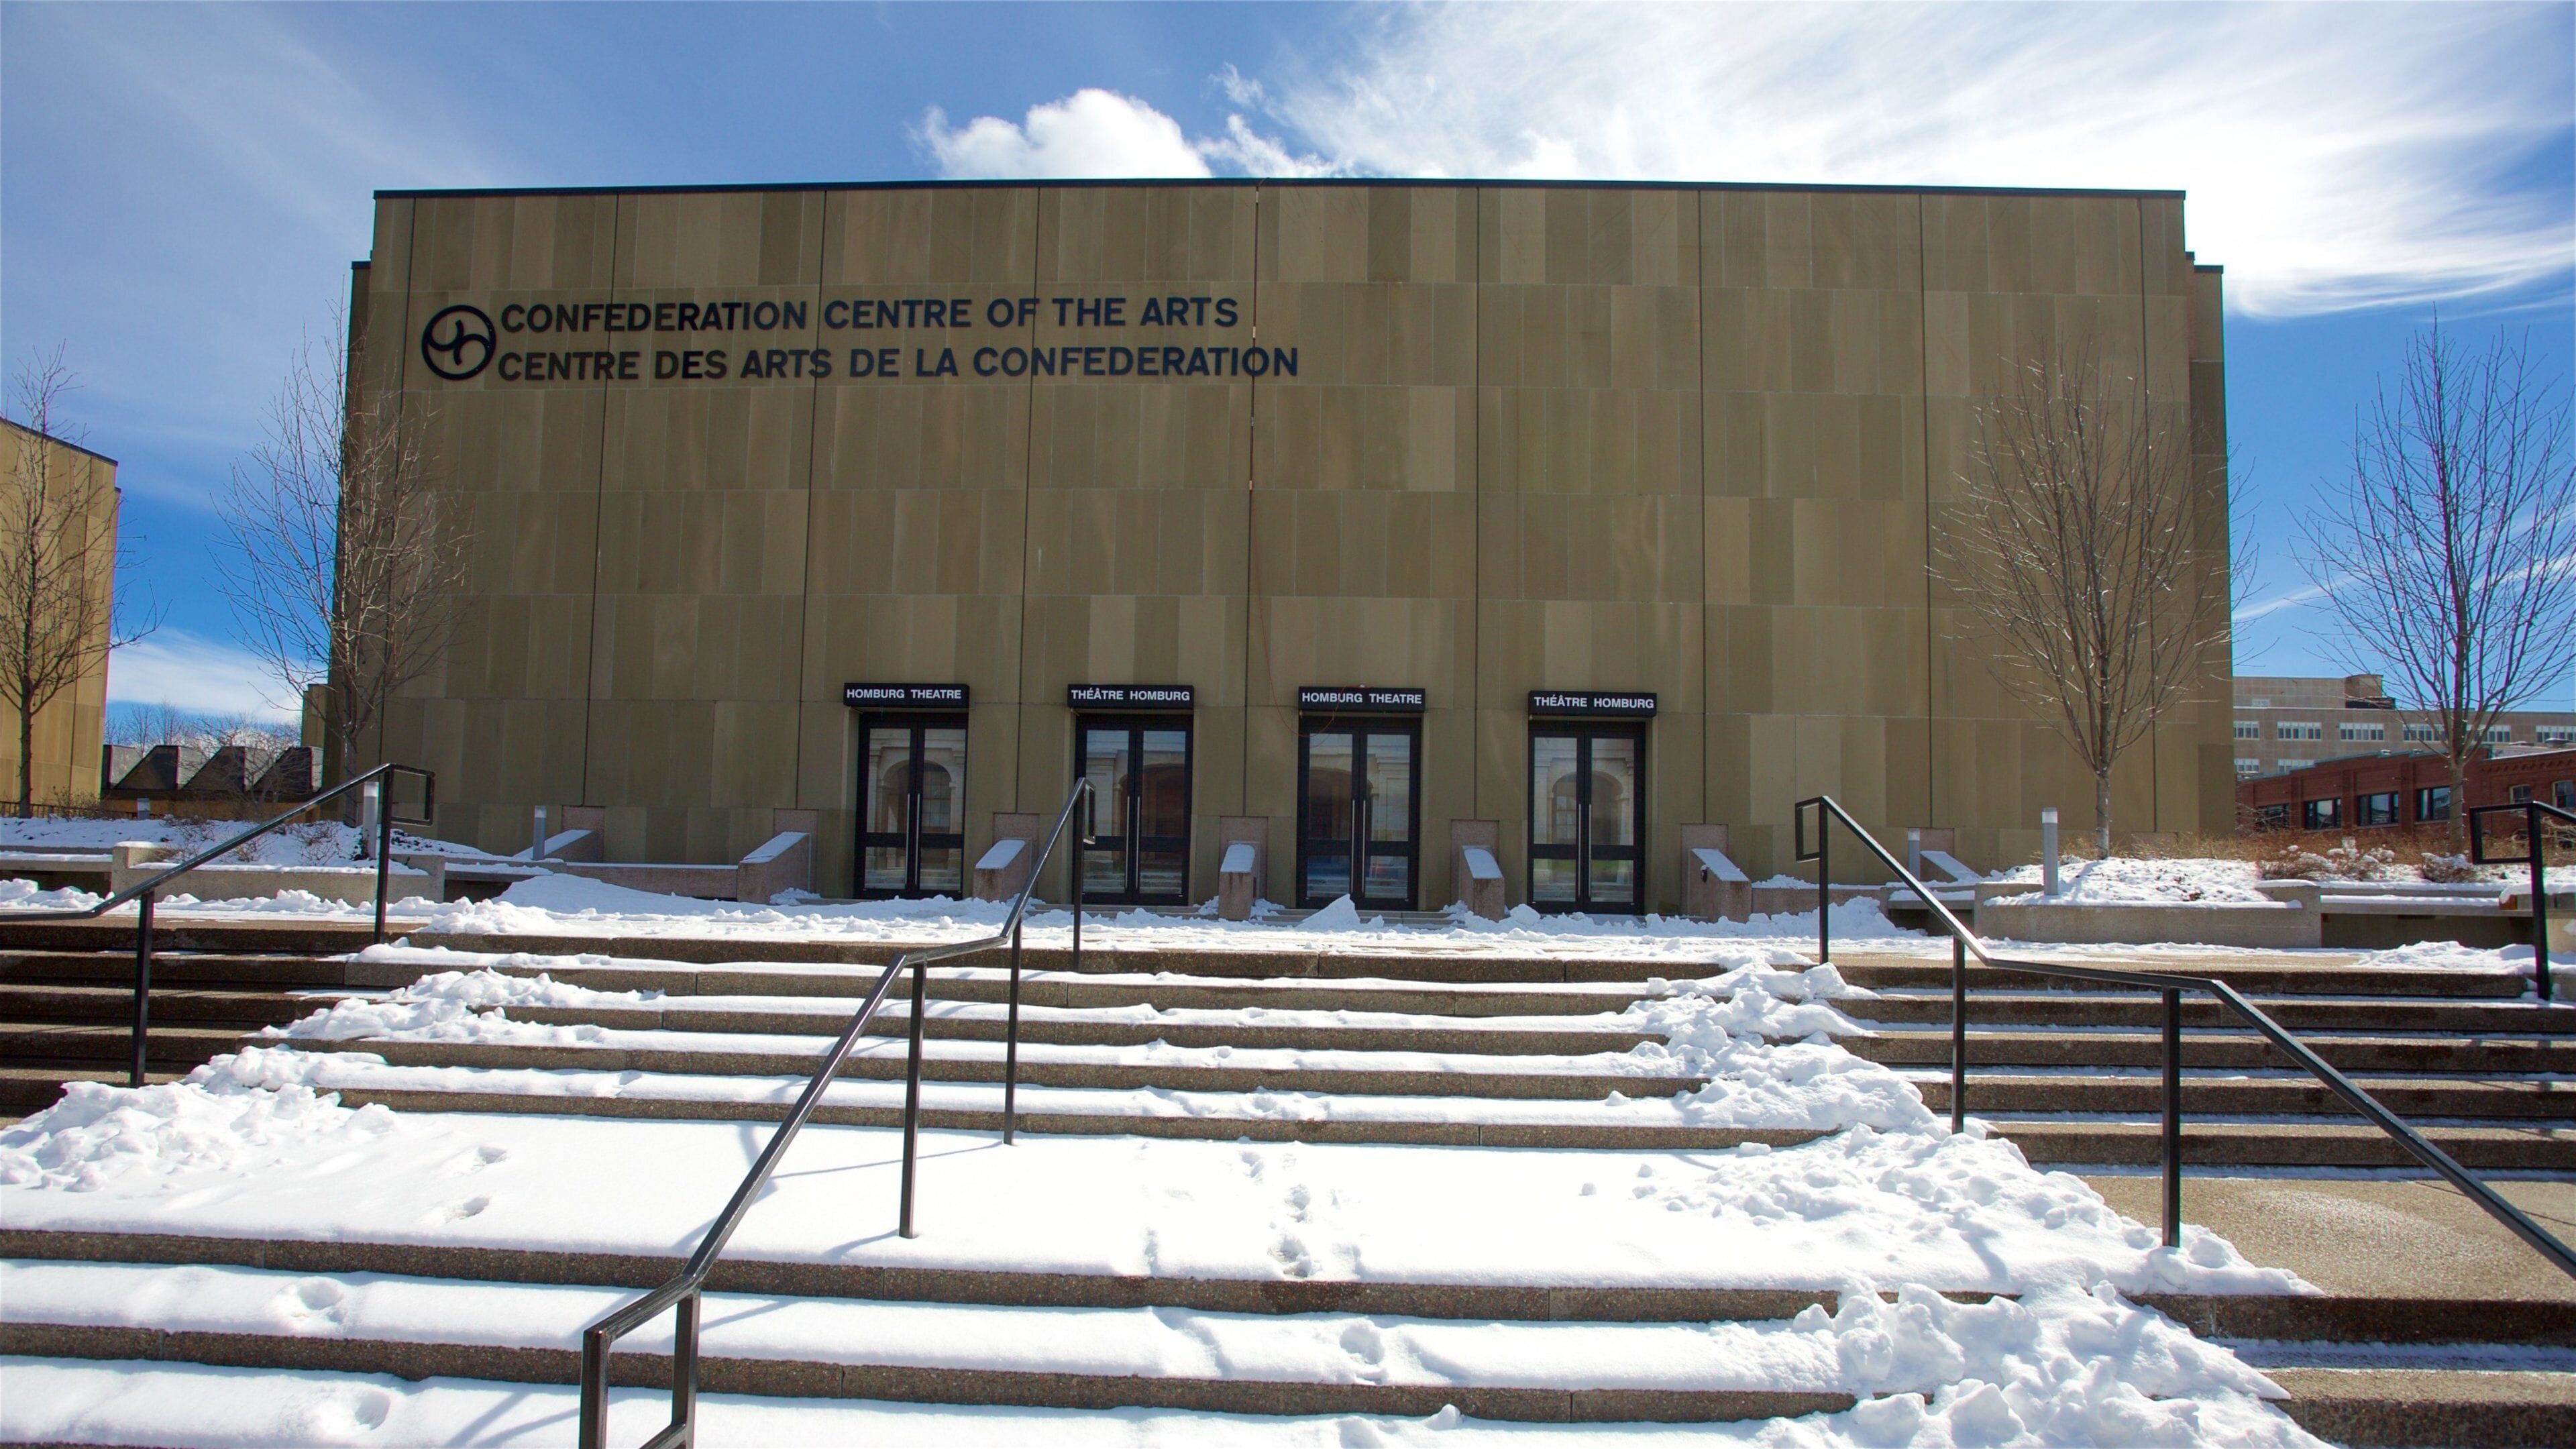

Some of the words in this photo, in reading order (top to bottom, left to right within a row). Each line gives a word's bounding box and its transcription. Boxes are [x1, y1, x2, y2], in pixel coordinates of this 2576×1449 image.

[500, 301, 806, 332] CONFEDERATION
[824, 299, 971, 329] CENTRE
[987, 298, 1038, 327] OF
[1052, 298, 1126, 327] THE
[1140, 297, 1238, 327] ARTS
[498, 352, 639, 381] CENTRE
[655, 350, 727, 380] DES
[740, 349, 832, 378] ARTS
[849, 348, 900, 377] DE
[916, 347, 959, 377] LA
[973, 347, 1297, 376] CONFEDERATION
[847, 689, 904, 699] HOMBURG
[910, 689, 961, 699] THEATRE
[1071, 687, 1124, 700] THÉÂTRE
[1130, 690, 1190, 702] HOMBURG
[1301, 692, 1362, 703] HOMBURG
[1369, 693, 1421, 704] THEATRE
[1534, 695, 1587, 707] THÉÂTRE
[1594, 698, 1654, 708] HOMBURG
